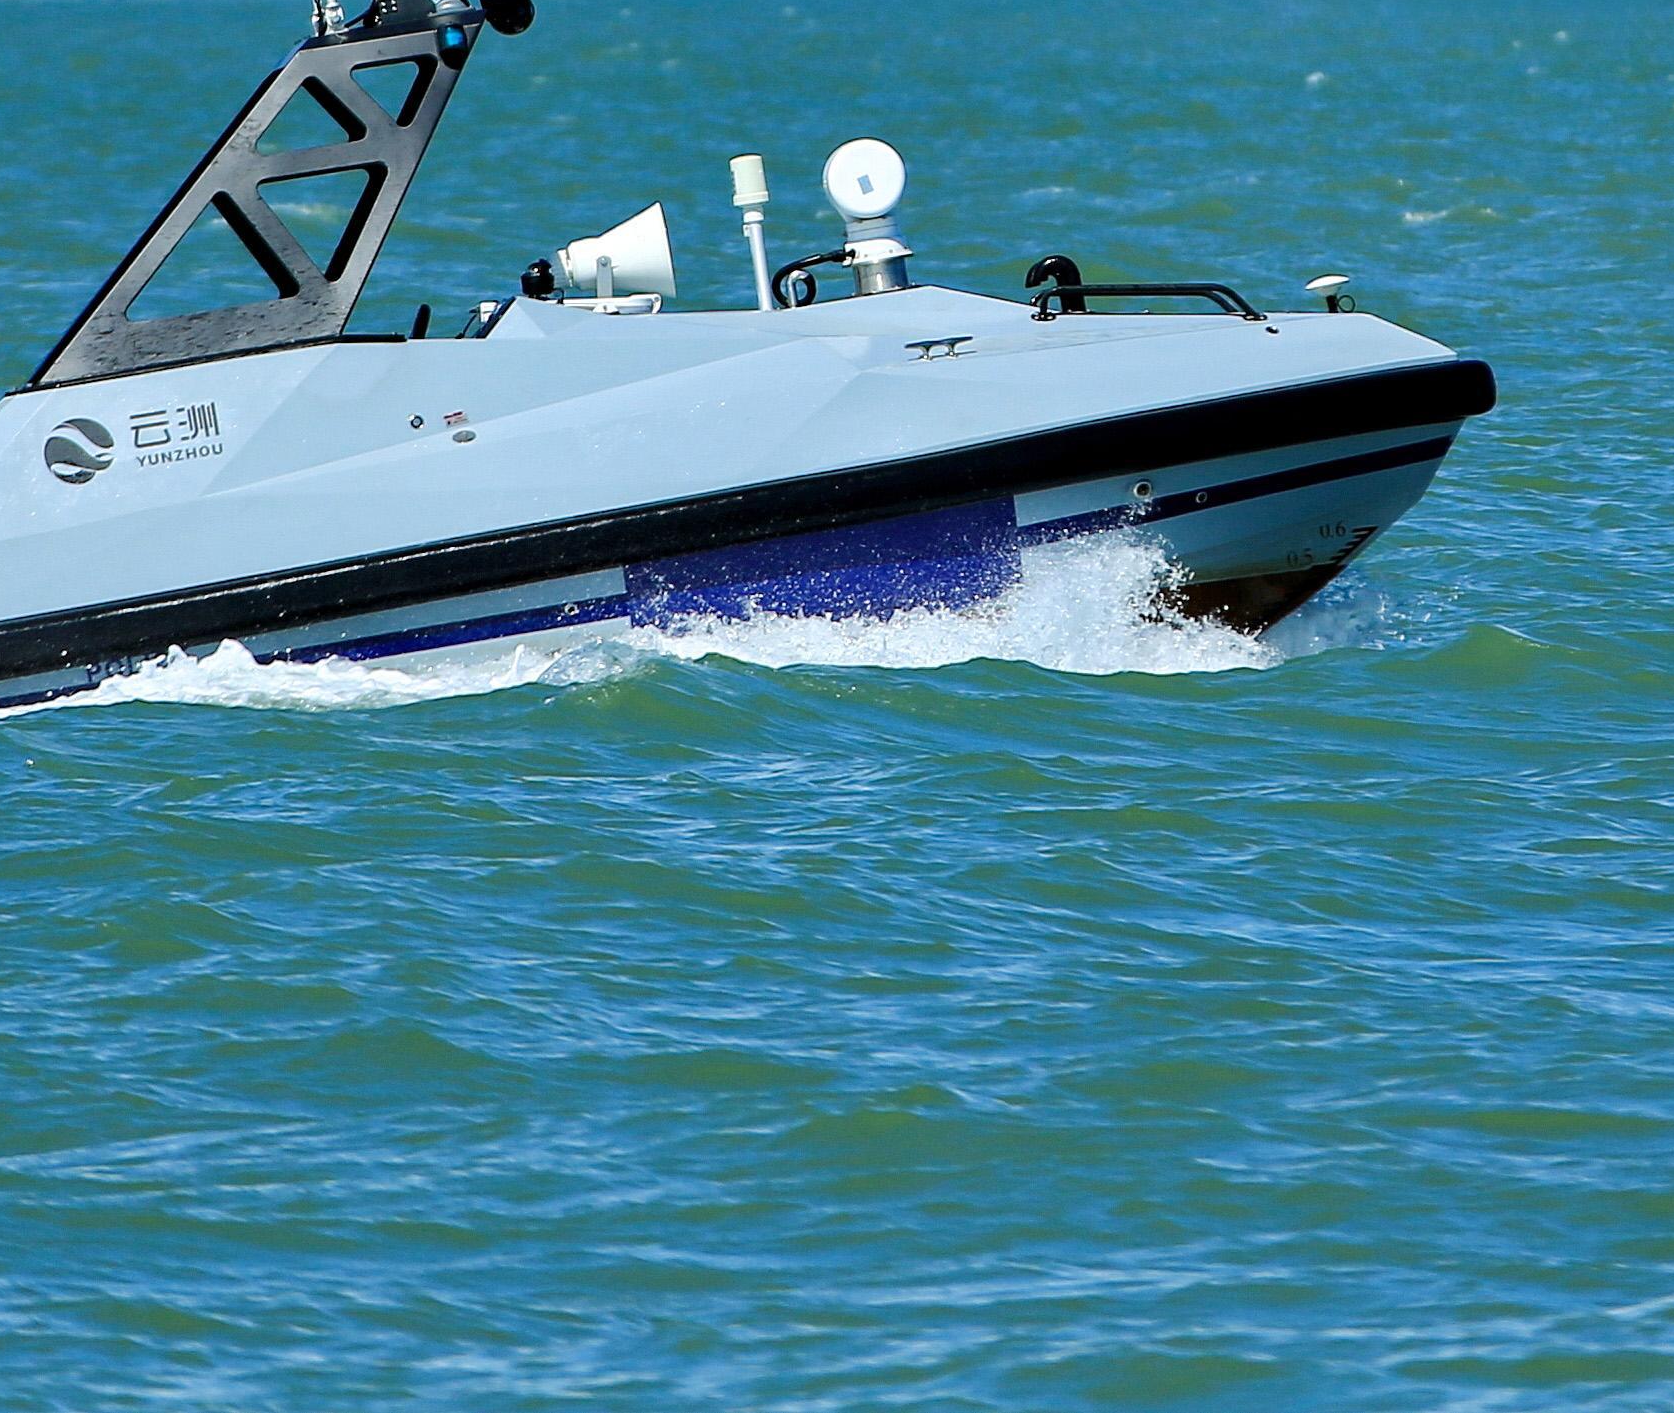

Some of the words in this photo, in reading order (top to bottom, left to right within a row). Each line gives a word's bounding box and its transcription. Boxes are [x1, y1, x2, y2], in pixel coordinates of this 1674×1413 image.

[129, 401, 220, 448] 云洲
[136, 442, 224, 467] YUNZHOU
[1319, 520, 1347, 539] 0.6
